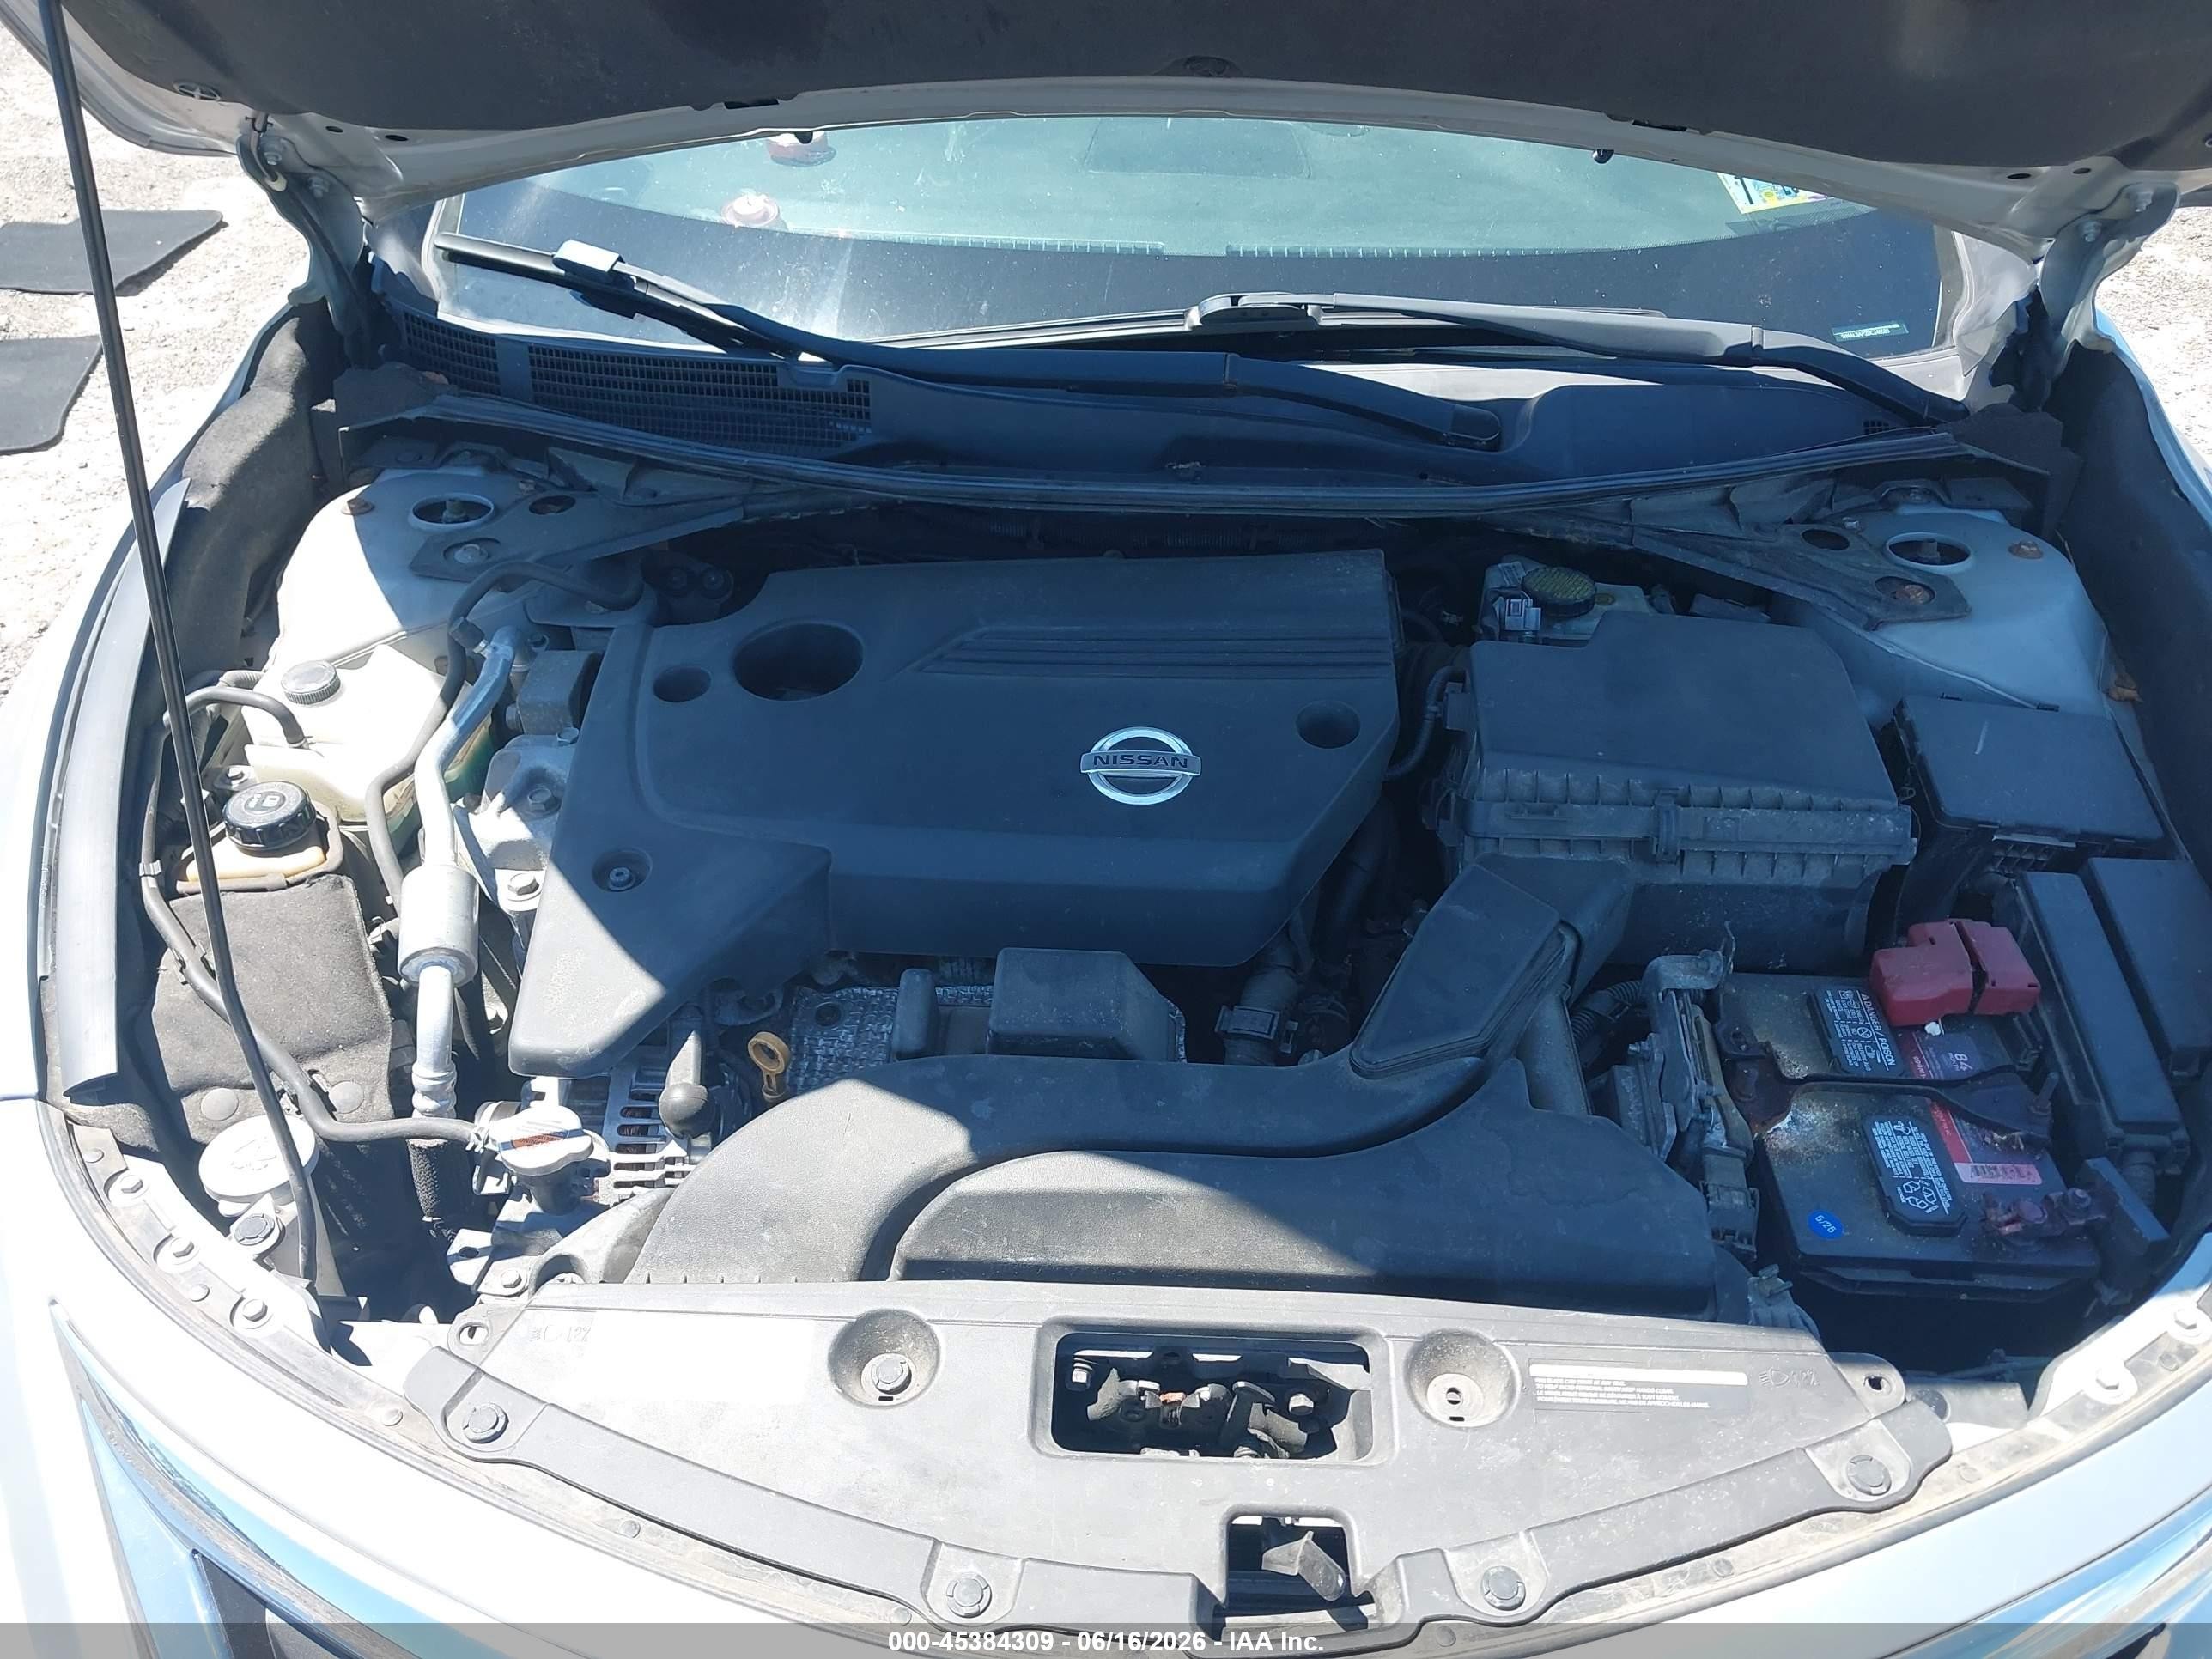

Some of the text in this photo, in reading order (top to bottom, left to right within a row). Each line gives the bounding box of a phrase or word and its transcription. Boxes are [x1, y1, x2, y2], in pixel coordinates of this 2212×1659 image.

[1094, 754, 1188, 768] NISSAN
[1864, 1000, 1882, 1031] DANGER
[1878, 1037, 1896, 1066] POISON
[1954, 1053, 1973, 1072] 84
